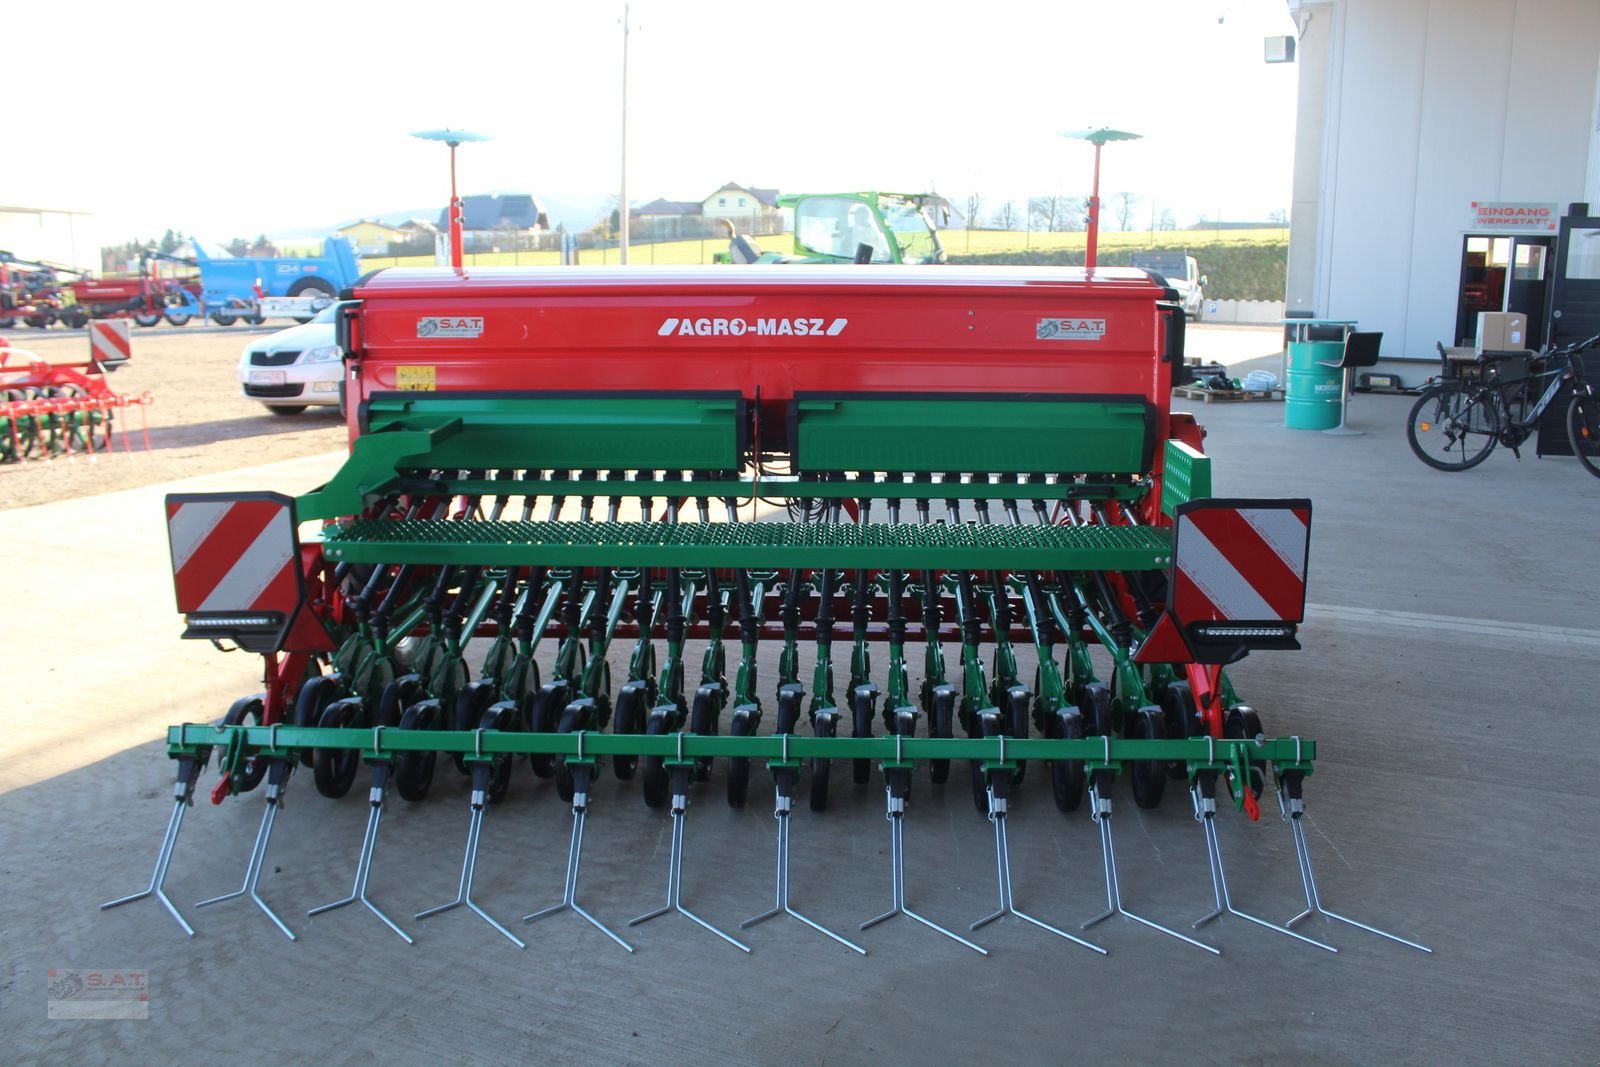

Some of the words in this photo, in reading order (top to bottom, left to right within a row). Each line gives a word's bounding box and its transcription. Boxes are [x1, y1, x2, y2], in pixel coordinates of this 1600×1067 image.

[1478, 207, 1551, 217] EINGANG
[1478, 217, 1550, 225] WERKSTATT
[440, 318, 482, 329] S.A.T.
[678, 317, 825, 337] AGRO-MASZ
[1060, 320, 1104, 331] S.A.T.
